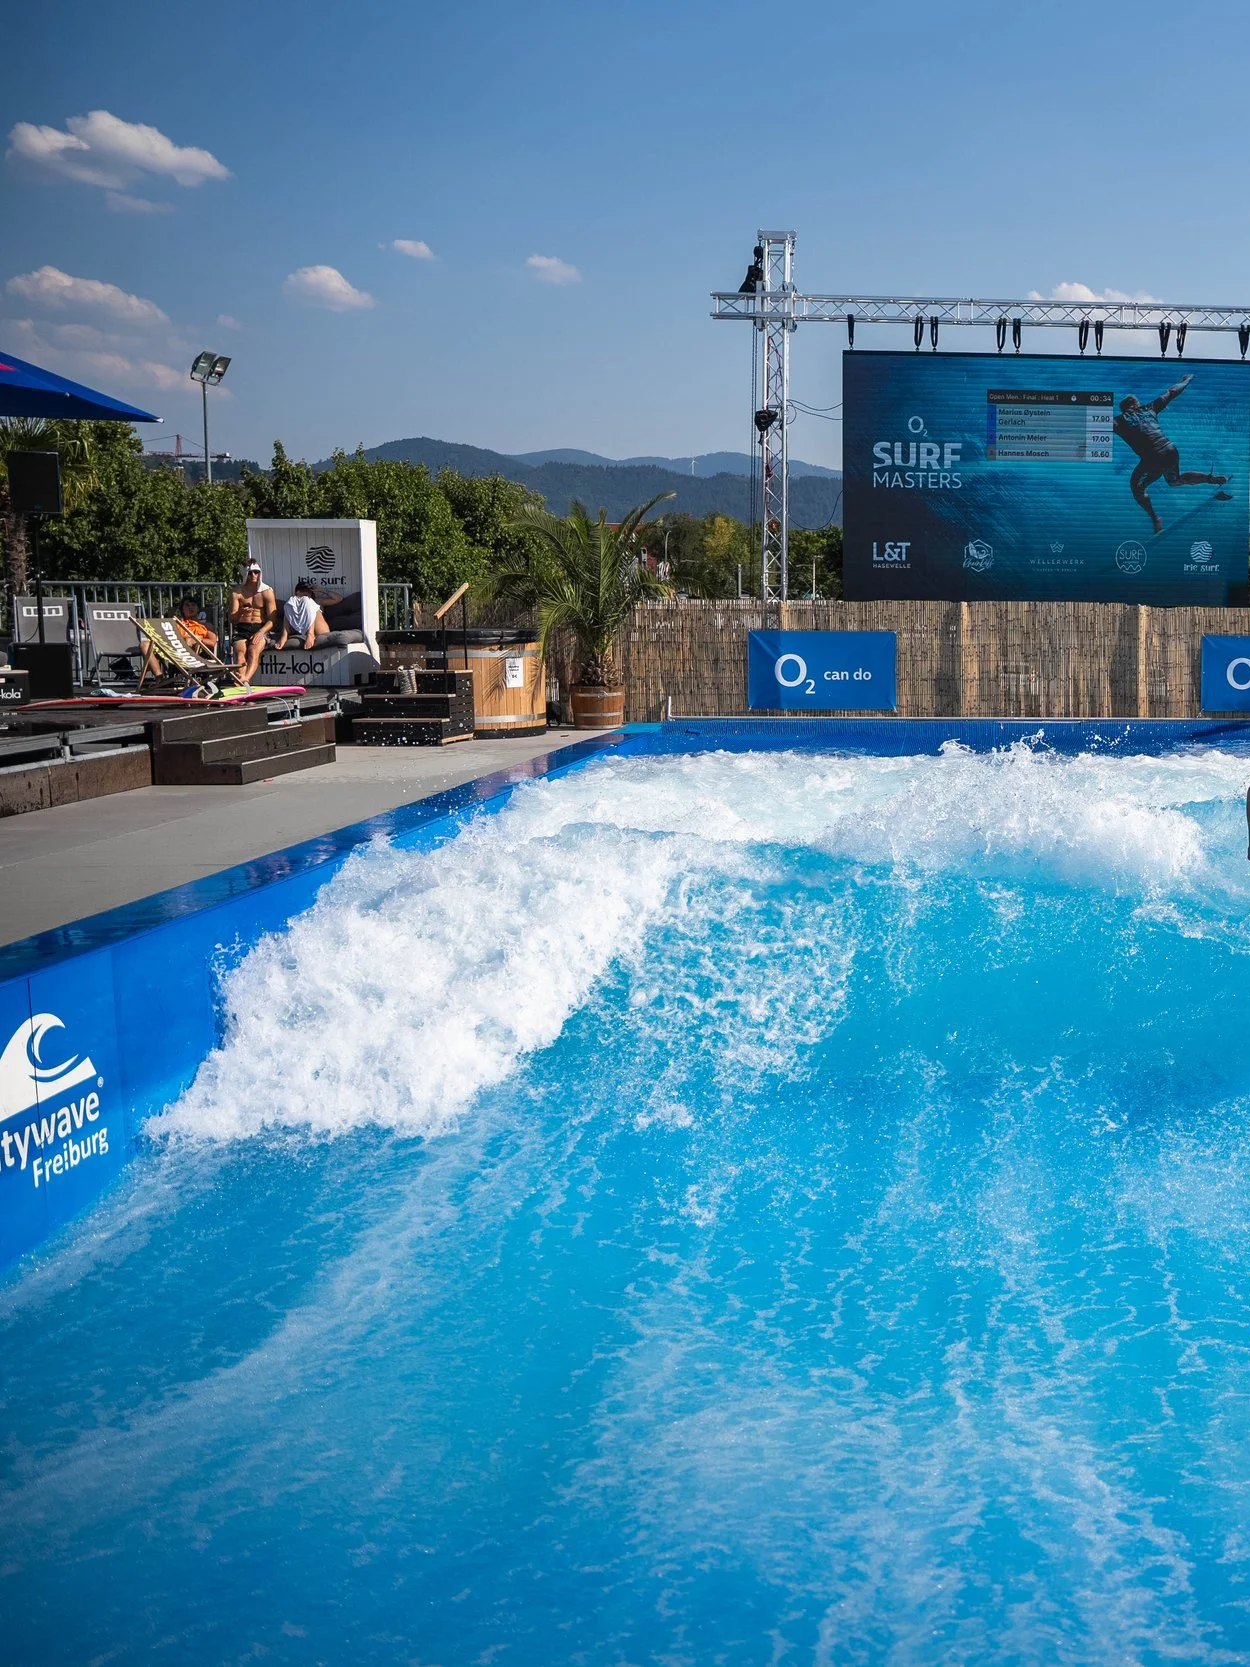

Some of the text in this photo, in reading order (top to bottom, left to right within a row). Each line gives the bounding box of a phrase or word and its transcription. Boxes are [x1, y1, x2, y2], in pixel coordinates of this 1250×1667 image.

[873, 441, 963, 469] SURF
[873, 472, 962, 489] MASTERS
[872, 541, 911, 561] L&T
[1119, 548, 1144, 561] SURF
[260, 655, 325, 675] fritz-kola
[823, 671, 849, 681] can
[853, 667, 872, 681] do
[0, 1091, 100, 1171] tywave
[32, 1127, 109, 1189] Freiburg
